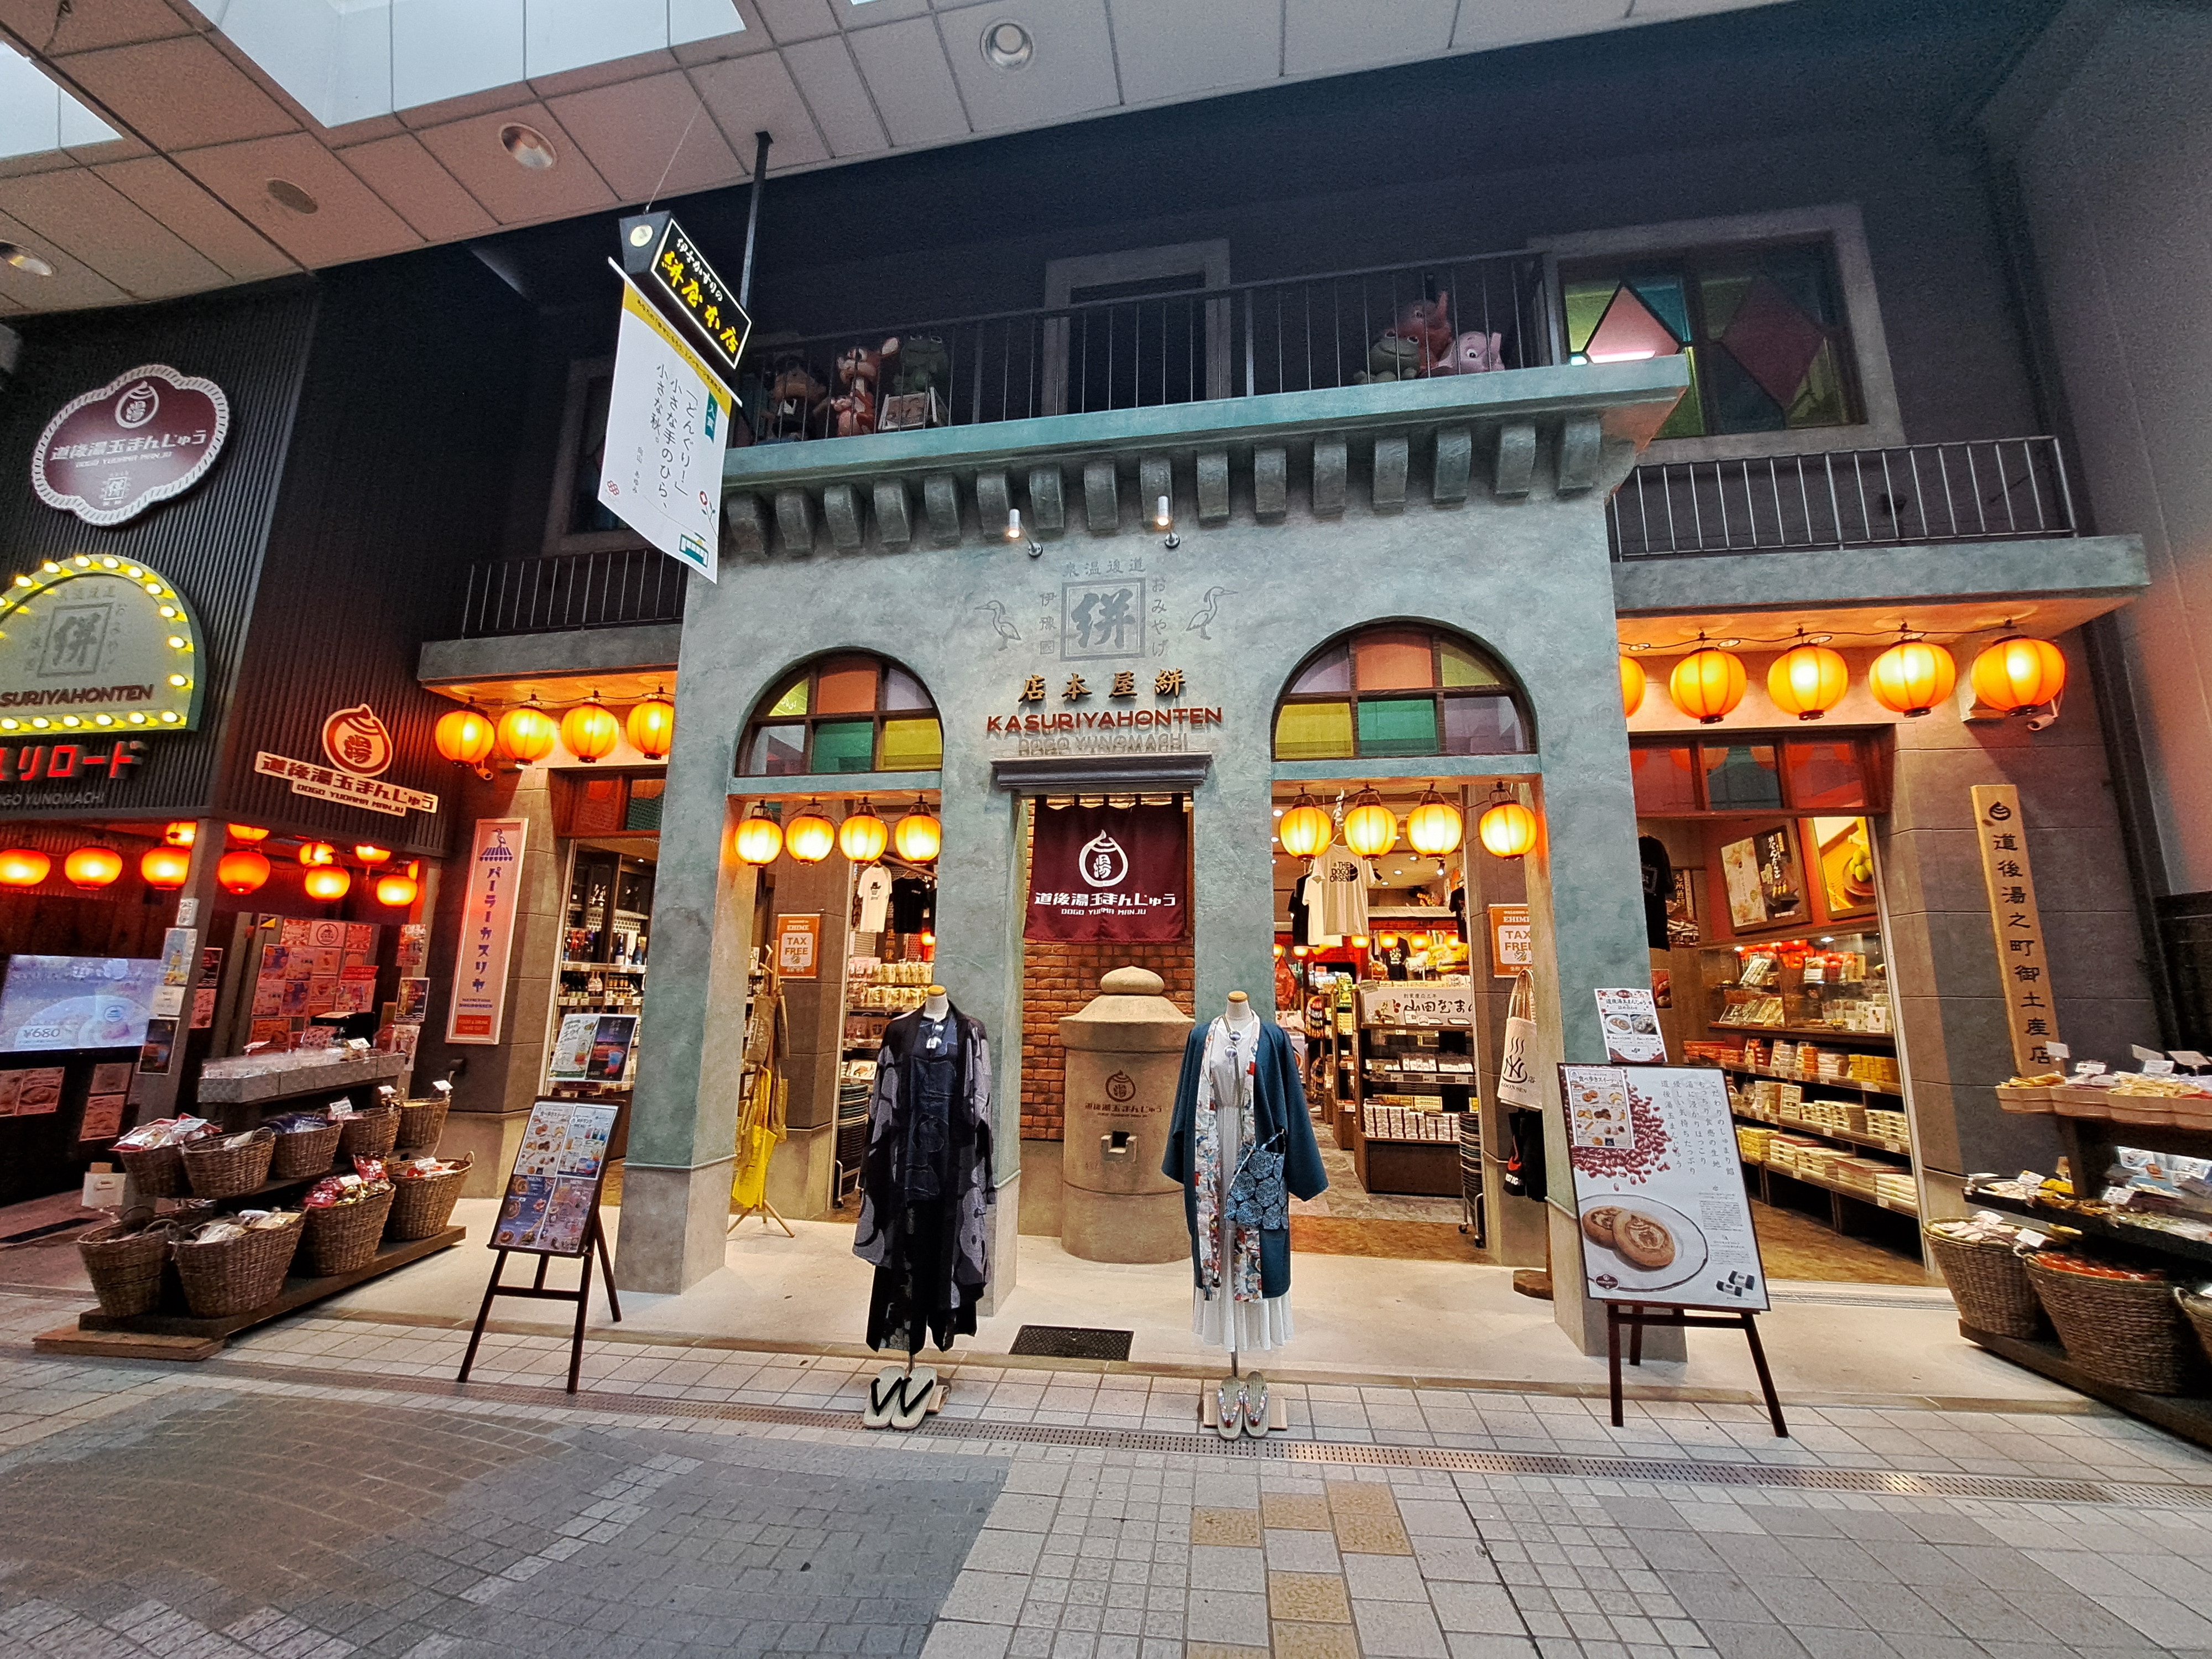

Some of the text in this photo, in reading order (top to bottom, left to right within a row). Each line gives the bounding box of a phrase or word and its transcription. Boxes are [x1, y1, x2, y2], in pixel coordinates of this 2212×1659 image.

[659, 378, 682, 508] 小さな手のひら、
[1151, 579, 1168, 657] おみやげ
[987, 708, 1222, 732] KASURIYAHONTEN
[0, 741, 142, 781] リロード
[262, 755, 434, 810] 道後湯玉まんじゅう
[298, 784, 326, 796] DOGO
[373, 801, 404, 813] MANJU
[1035, 892, 1176, 906] 道後湯玉まんじゅう
[472, 867, 501, 993] パーラーカスリヤ
[1505, 931, 1531, 939] TAX
[1994, 833, 2051, 1065] 道後湯之町御土産店
